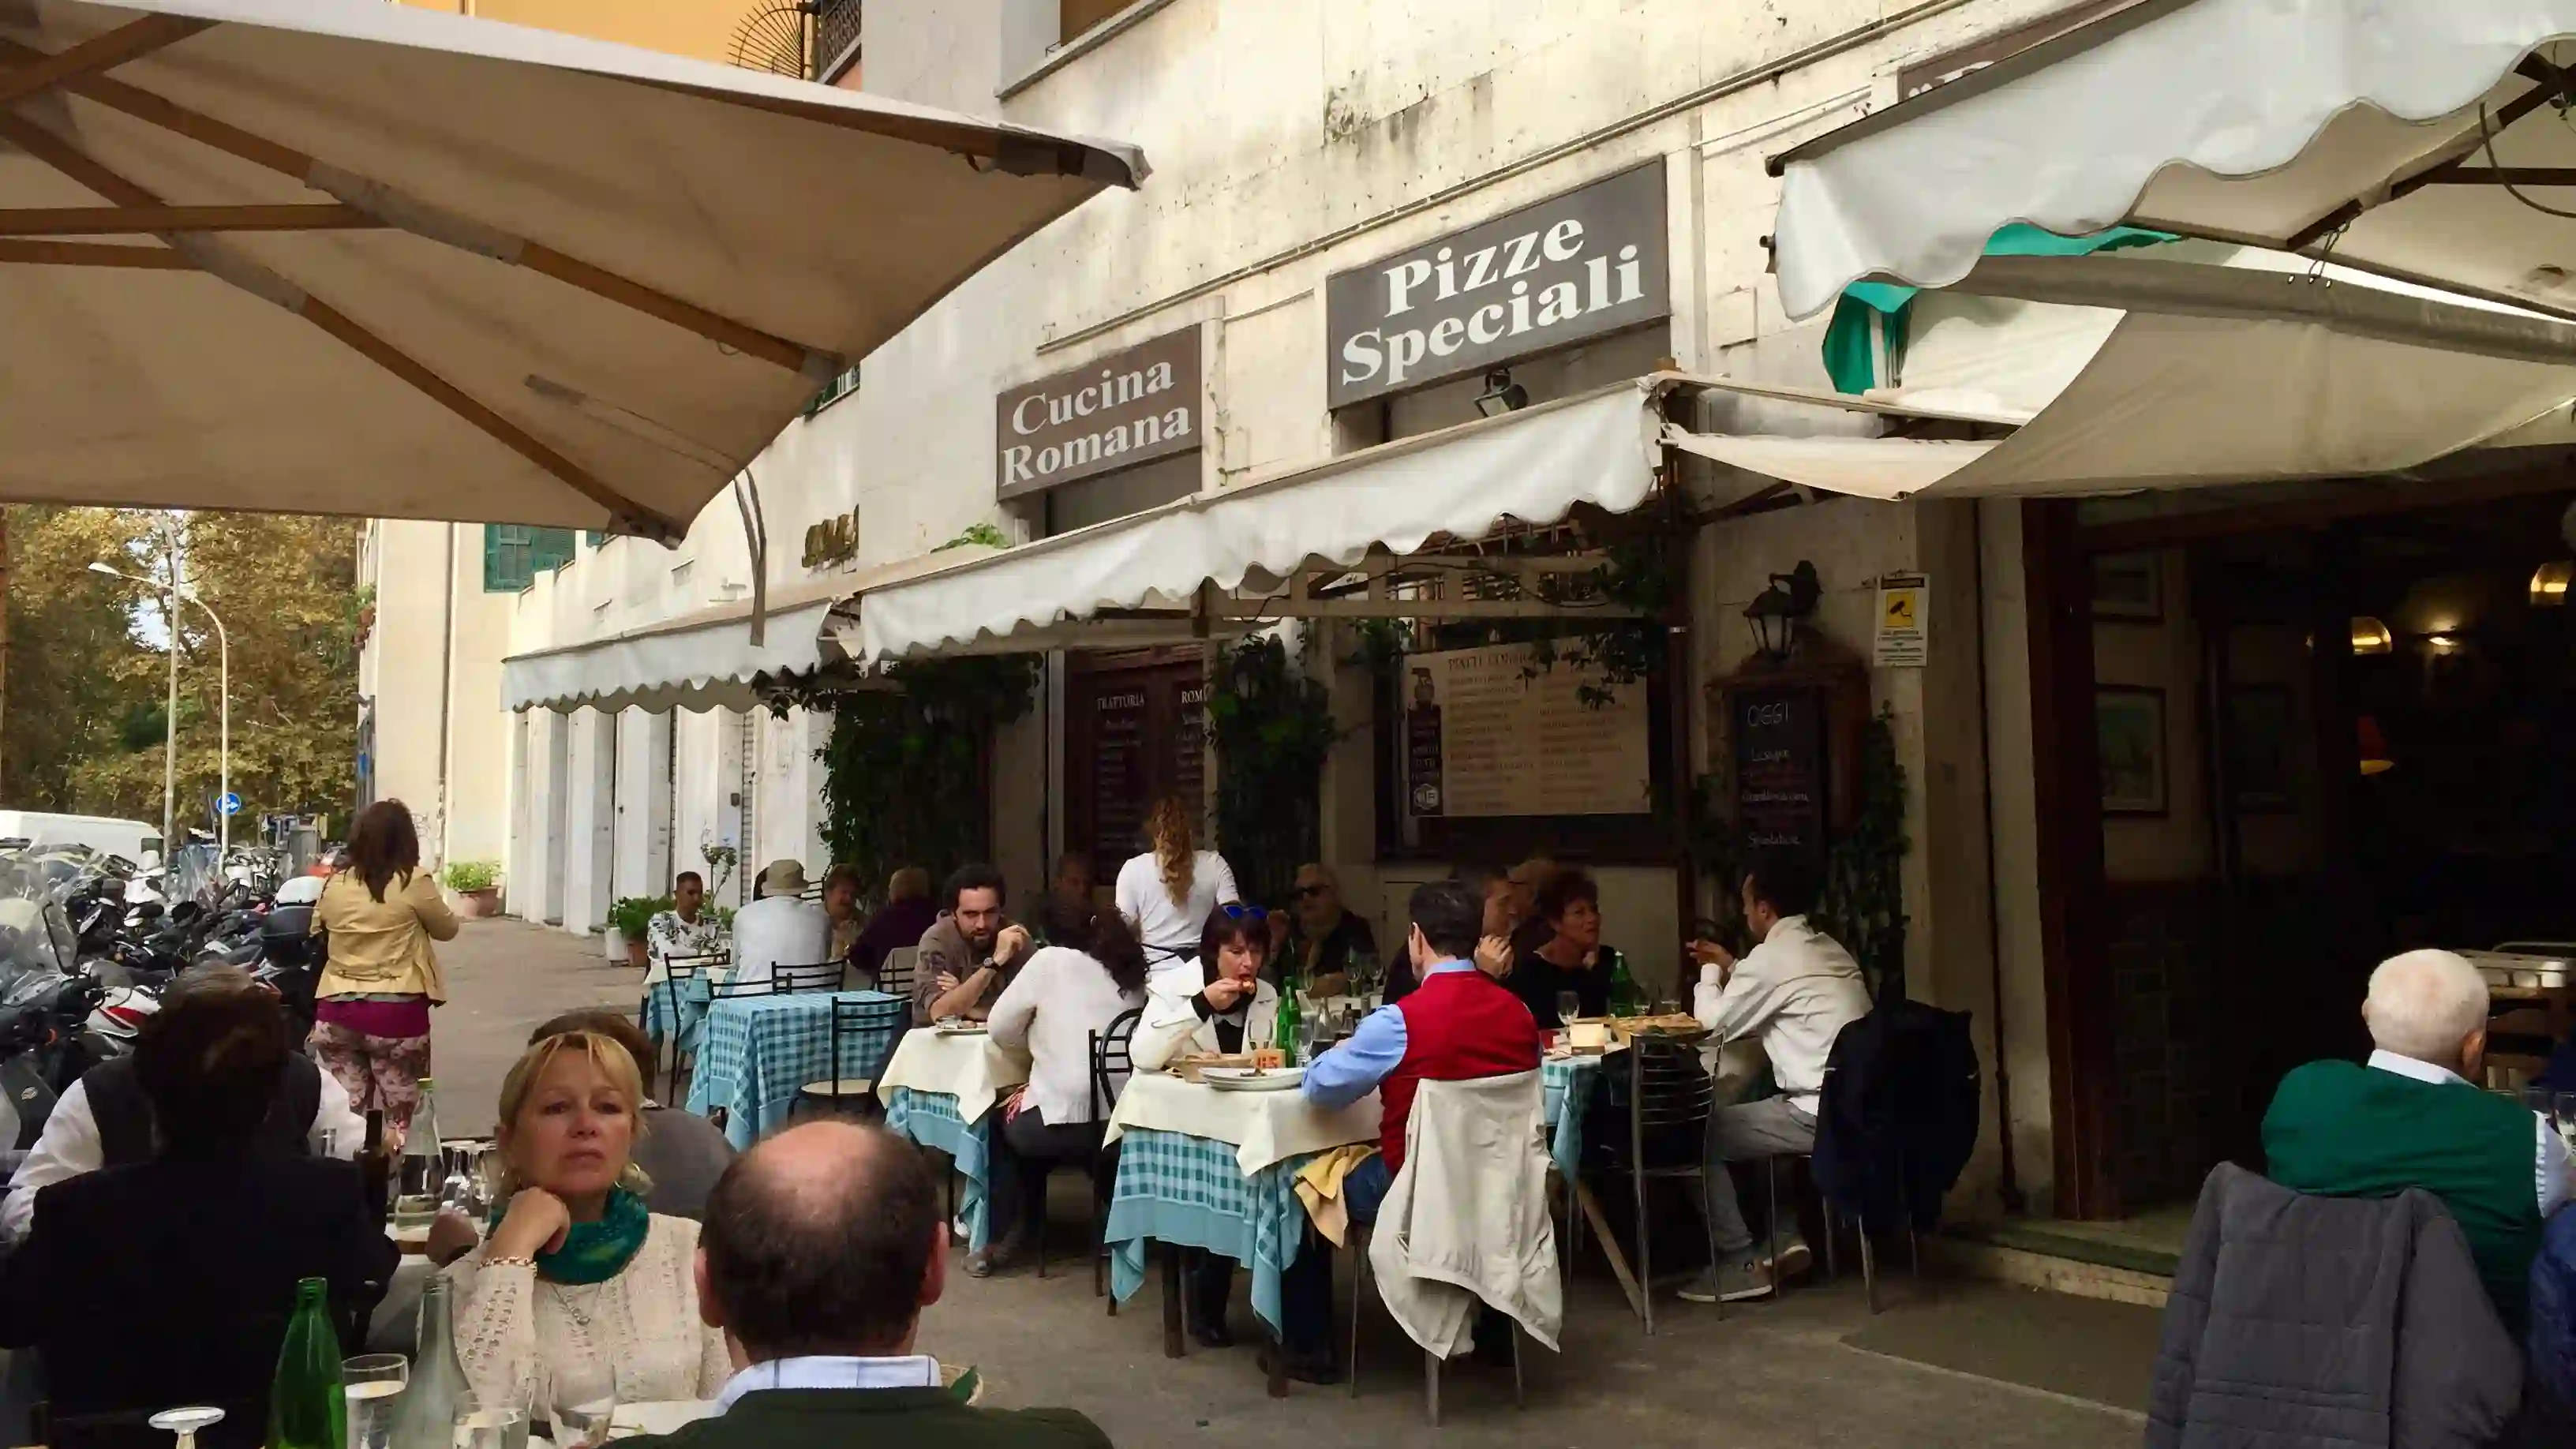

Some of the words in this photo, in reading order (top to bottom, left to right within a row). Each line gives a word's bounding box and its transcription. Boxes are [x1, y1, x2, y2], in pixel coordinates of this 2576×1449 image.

[1382, 218, 1585, 317] Pizze
[1341, 245, 1645, 387] Speciali
[1011, 360, 1175, 437] Cucina
[1001, 406, 1193, 489] Romana
[1096, 692, 1145, 712] TRATTORIA
[1181, 689, 1204, 704] ROM
[1747, 702, 1791, 727] OGGI
